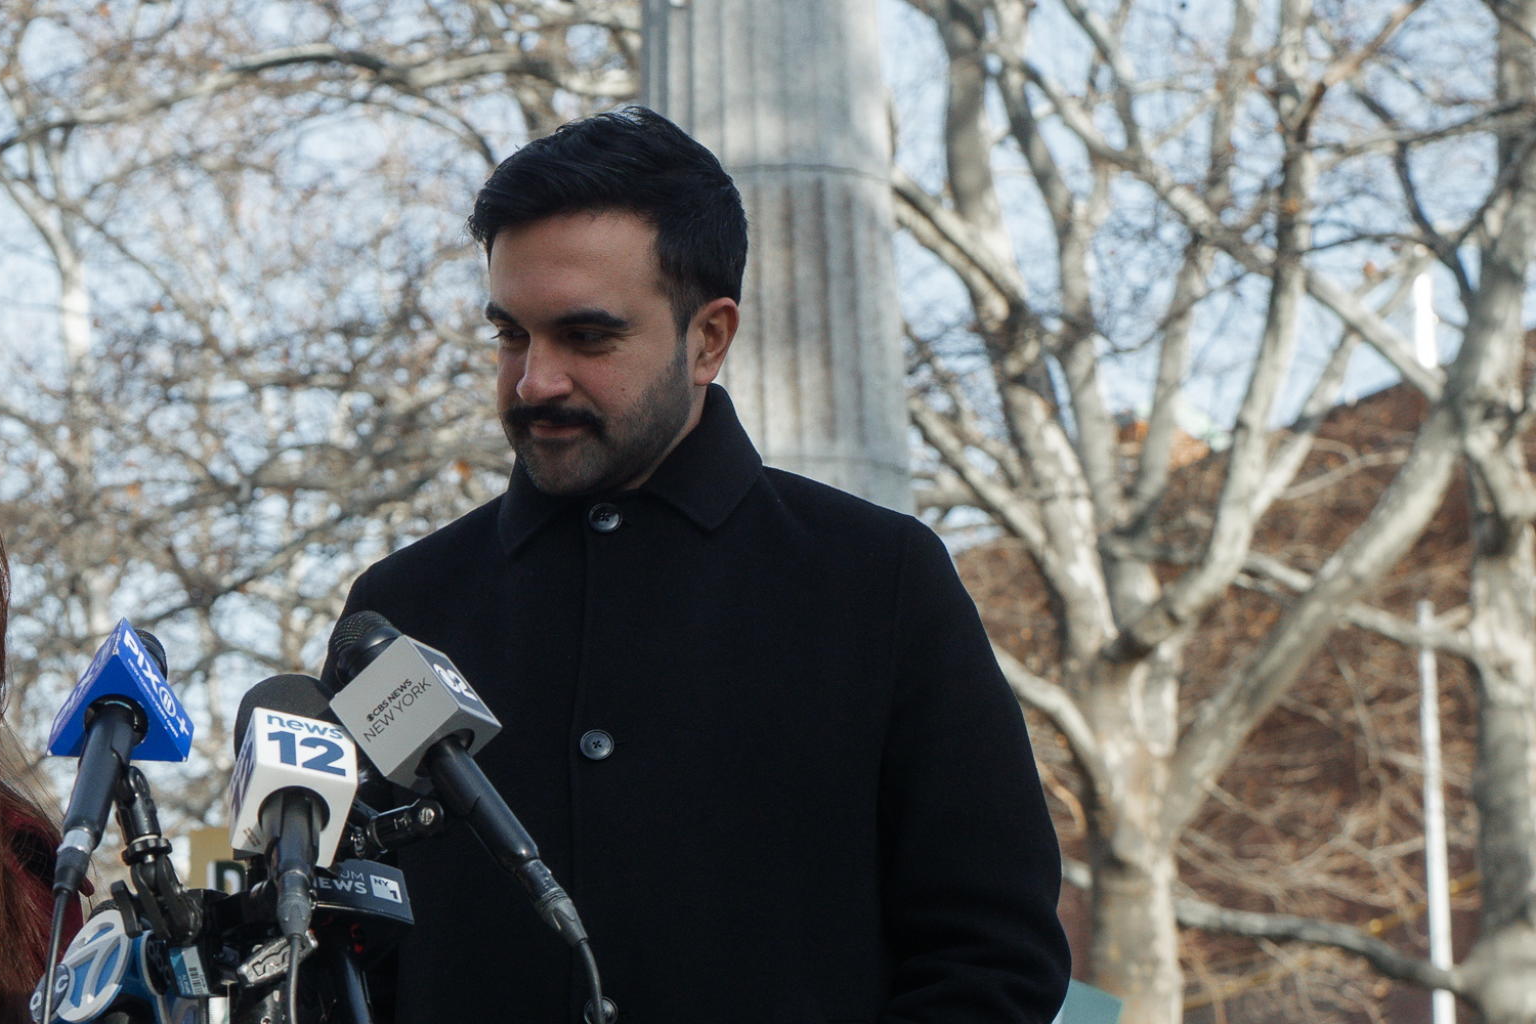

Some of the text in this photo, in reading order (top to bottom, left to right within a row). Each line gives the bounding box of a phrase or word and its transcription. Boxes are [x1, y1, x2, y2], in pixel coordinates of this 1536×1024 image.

[363, 677, 432, 743] NEW YORK
[372, 678, 413, 717] CBS NEWS
[267, 714, 343, 740] news
[267, 730, 346, 777] 12
[374, 878, 389, 887] NY
[389, 889, 399, 900] 1
